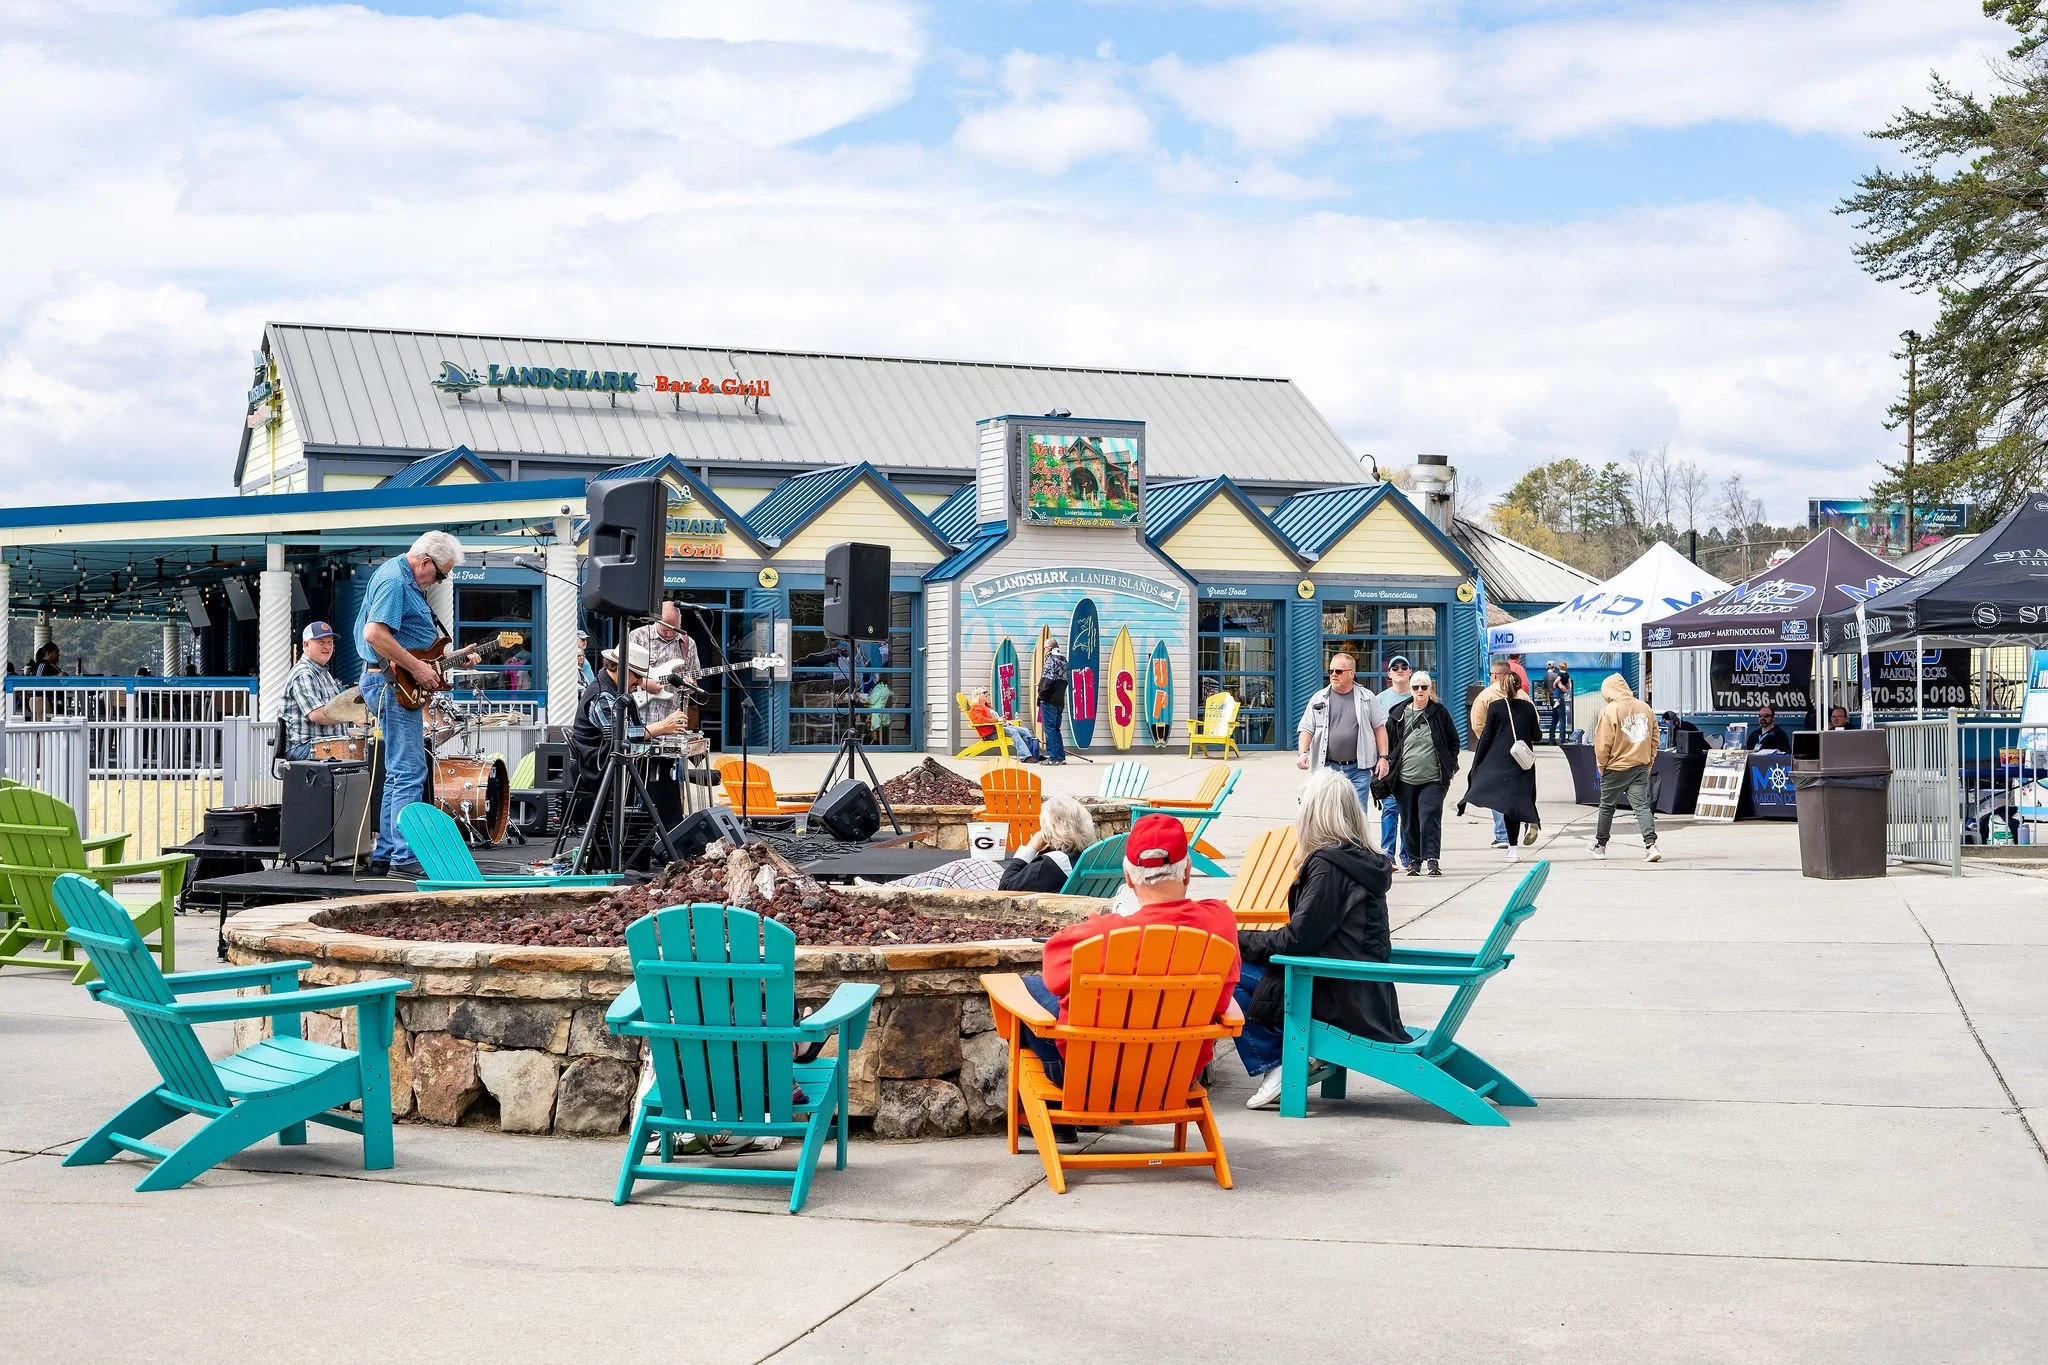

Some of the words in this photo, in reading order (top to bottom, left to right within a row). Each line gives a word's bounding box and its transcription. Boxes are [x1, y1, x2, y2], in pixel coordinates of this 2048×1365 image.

[488, 364, 637, 392] LANDSHARK
[655, 376, 692, 393] Bar
[698, 378, 714, 395] &
[719, 378, 770, 396] Grill
[666, 518, 727, 534] SHARK
[679, 543, 724, 556] Grill
[462, 570, 486, 580] Food
[996, 571, 1068, 593] LANDSHARK
[1080, 574, 1117, 586] LANIER
[1118, 575, 1159, 596] ISLANDS
[1206, 586, 1228, 598] Great
[1228, 587, 1247, 596] Food
[1353, 589, 1378, 598] Frozen
[1379, 590, 1418, 599] Concoctions
[1677, 630, 1711, 640] 770-536-0189
[1717, 628, 1775, 636] MARTINDOCKS.COM
[1843, 616, 1891, 639] STAESIDE
[1922, 667, 1947, 678] OCKS
[1717, 690, 1807, 708] 770-536-0189
[1872, 686, 1966, 703] 70-53-0189
